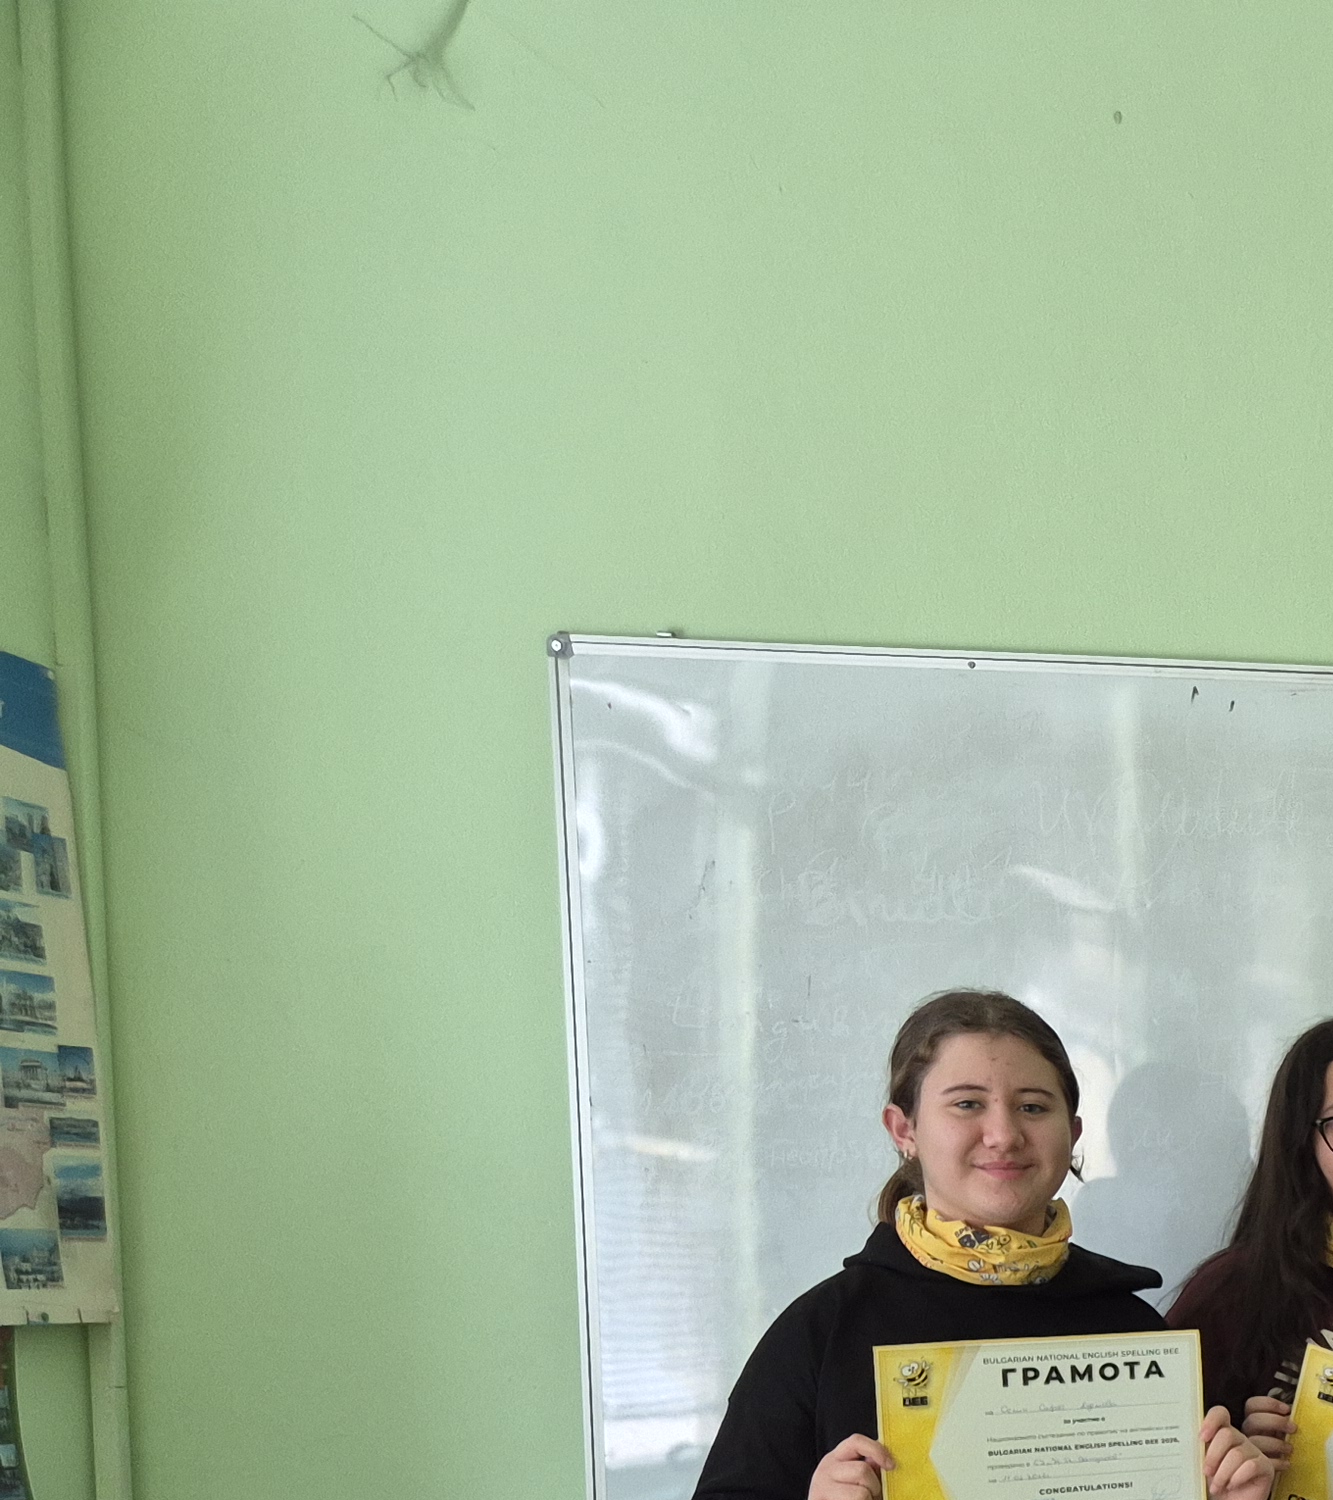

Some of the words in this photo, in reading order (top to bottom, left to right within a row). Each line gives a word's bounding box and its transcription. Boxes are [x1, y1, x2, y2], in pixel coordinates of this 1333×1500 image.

[982, 1355, 1034, 1364] BULGARIAN
[1036, 1353, 1080, 1361] NATIONAL
[1082, 1351, 1118, 1359] ENGLISH
[1120, 1349, 1160, 1357] SPELLING
[1001, 1359, 1164, 1387] ГРАМОТА
[988, 1447, 1032, 1456] BULGARIAN
[1034, 1444, 1072, 1453] NATIONAL
[1074, 1442, 1106, 1450] ENGLISH
[1108, 1439, 1143, 1447] SPELLING
[1039, 1481, 1132, 1495] CONGRATULATIONS!
